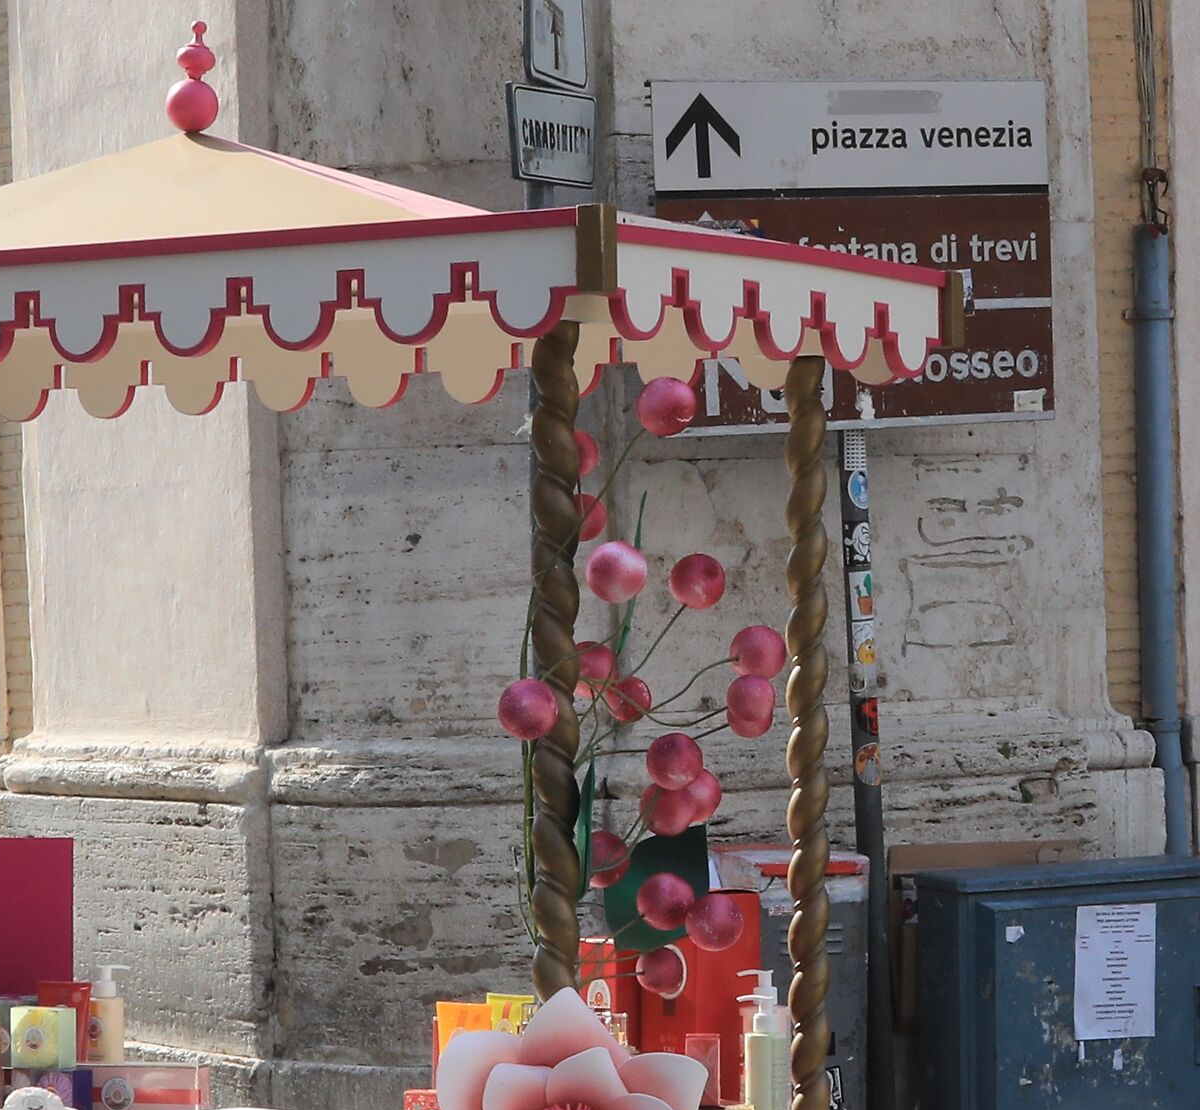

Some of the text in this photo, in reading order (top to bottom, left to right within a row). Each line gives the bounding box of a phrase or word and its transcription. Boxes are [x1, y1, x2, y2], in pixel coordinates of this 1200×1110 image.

[811, 120, 1033, 155] piazza venezia
[931, 233, 957, 263] di
[970, 232, 1039, 262] trevi
